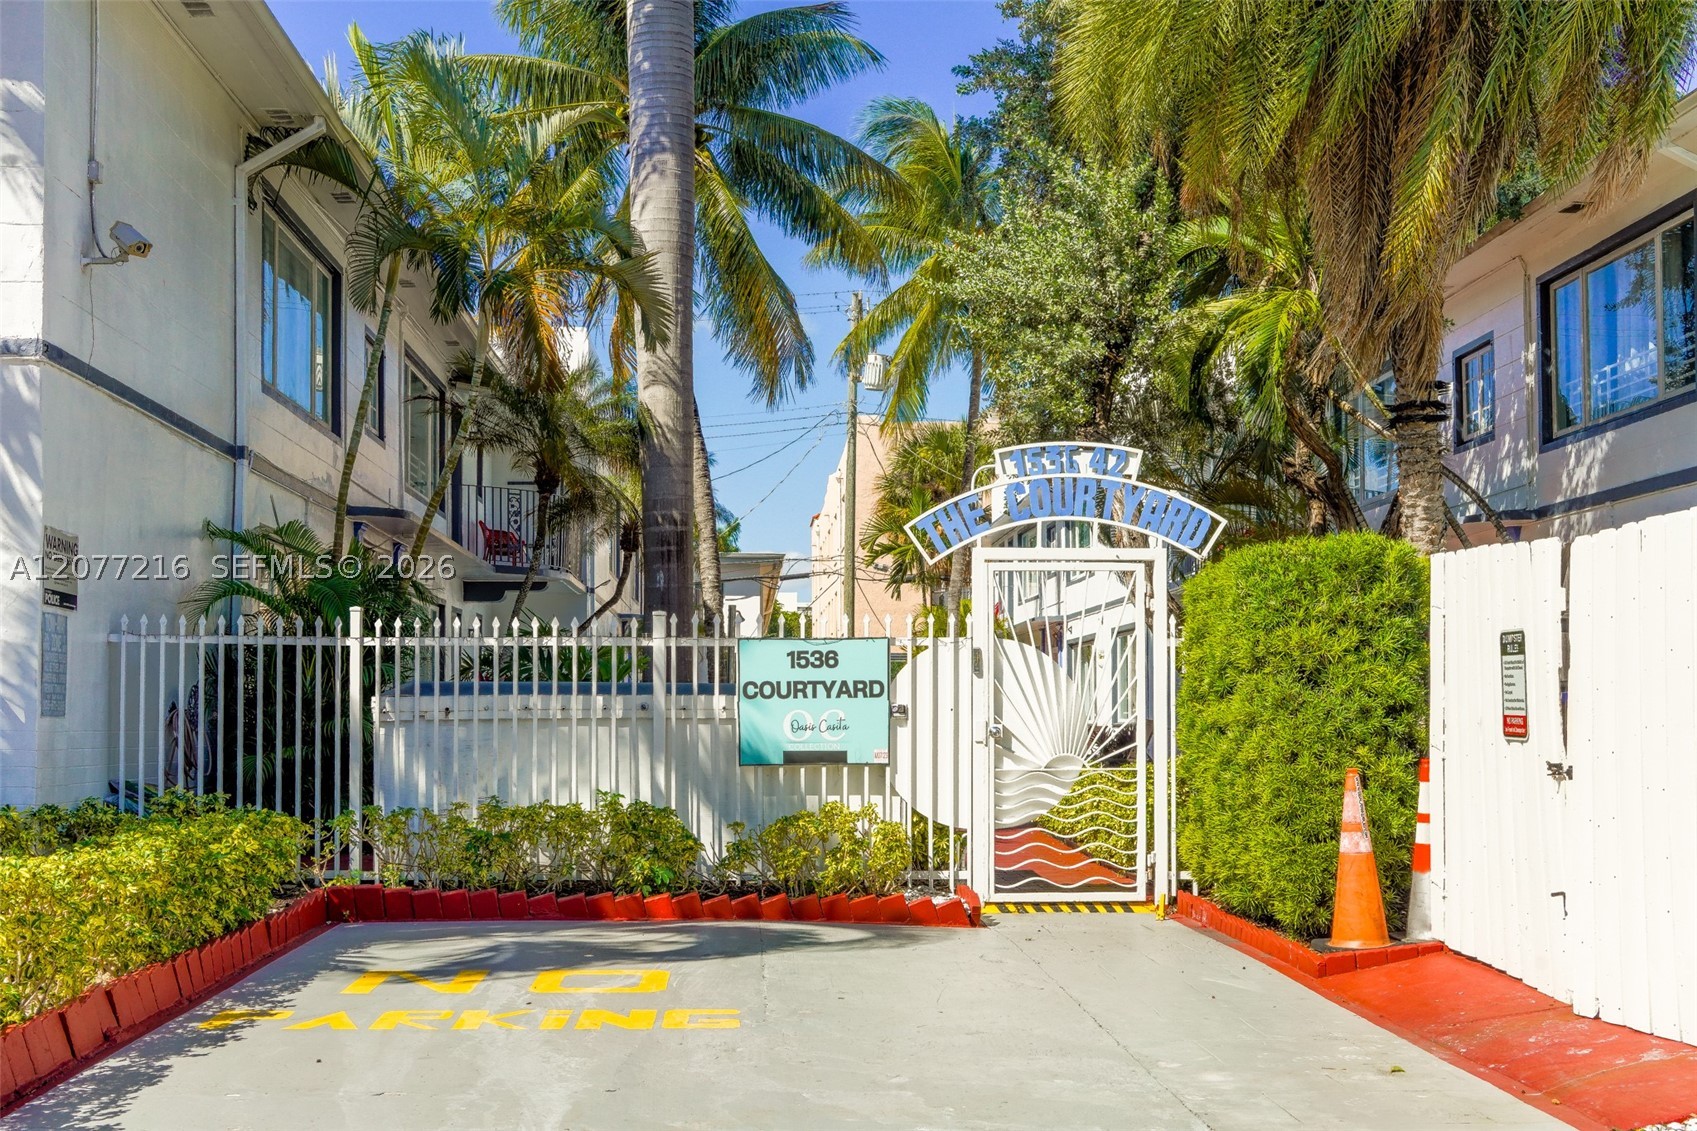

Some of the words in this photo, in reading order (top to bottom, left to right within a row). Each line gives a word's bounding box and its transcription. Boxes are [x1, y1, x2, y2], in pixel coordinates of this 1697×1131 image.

[915, 493, 993, 555] THE
[1005, 476, 1212, 549] COURTYARD
[45, 533, 79, 557] WARNING
[45, 592, 60, 606] POLICE
[786, 650, 839, 669] 1536
[742, 680, 885, 700] COURTYARD
[790, 719, 816, 733] Oasis
[818, 717, 850, 733] Casita
[340, 969, 671, 994] NO
[197, 1009, 742, 1031] PARKING
